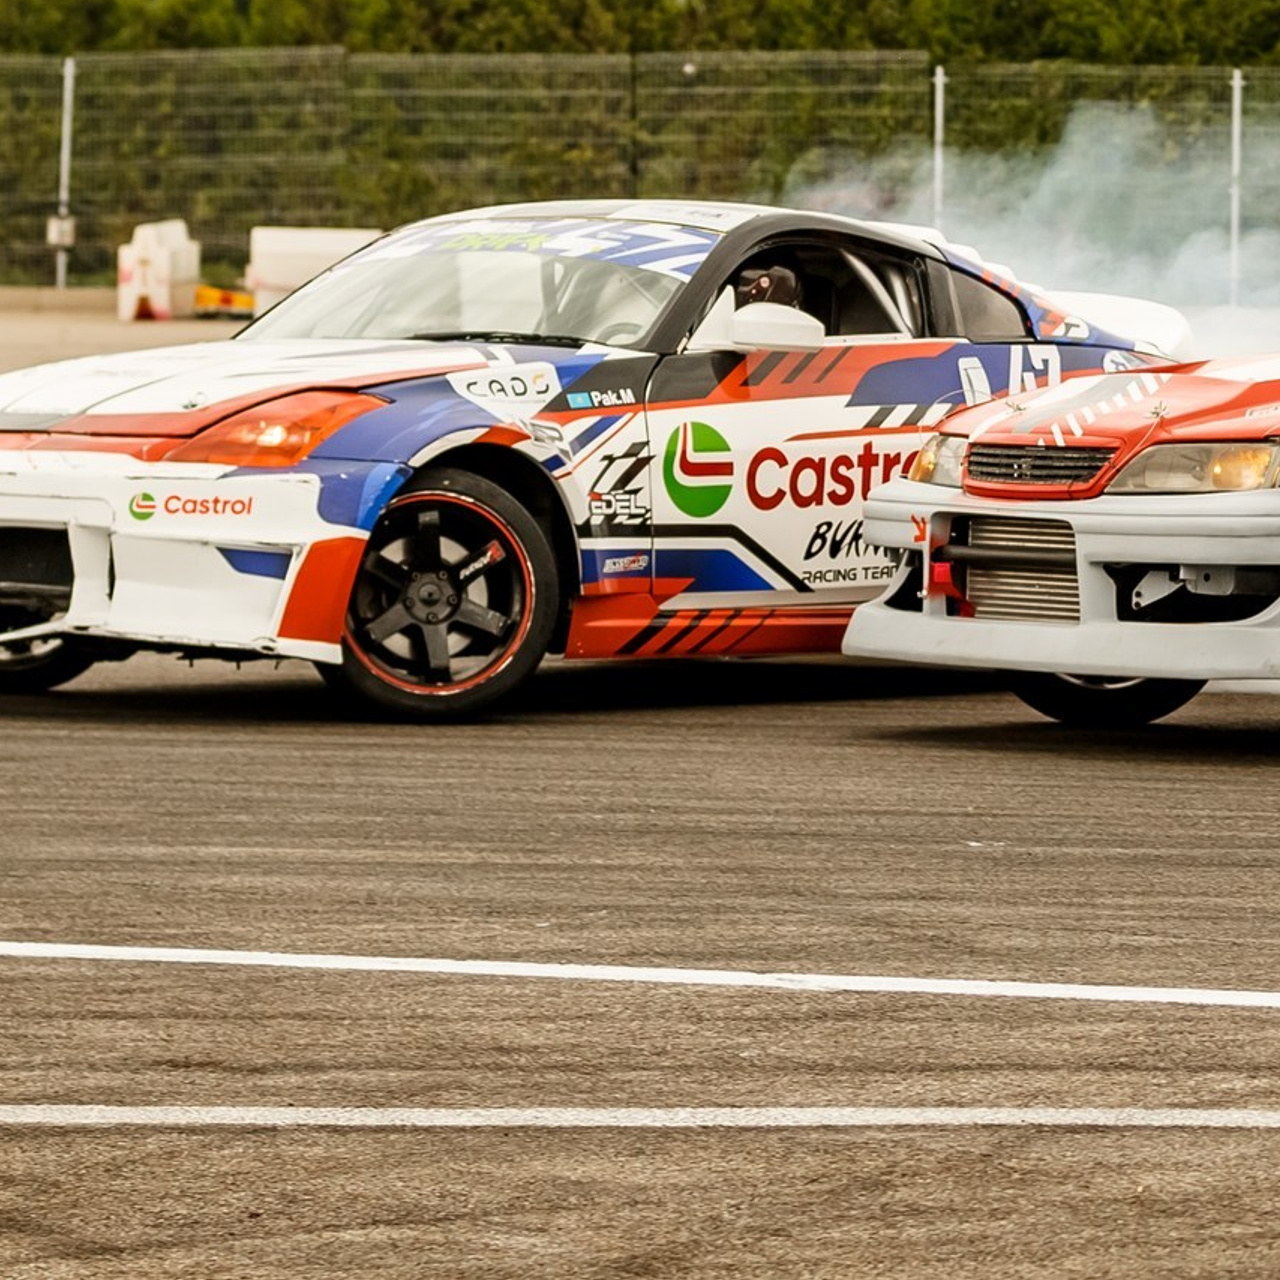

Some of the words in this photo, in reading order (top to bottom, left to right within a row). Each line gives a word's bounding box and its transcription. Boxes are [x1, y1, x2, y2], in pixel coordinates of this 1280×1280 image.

[590, 388, 635, 407] Pak.M
[164, 495, 252, 515] Castrol
[801, 567, 857, 583] RACING
